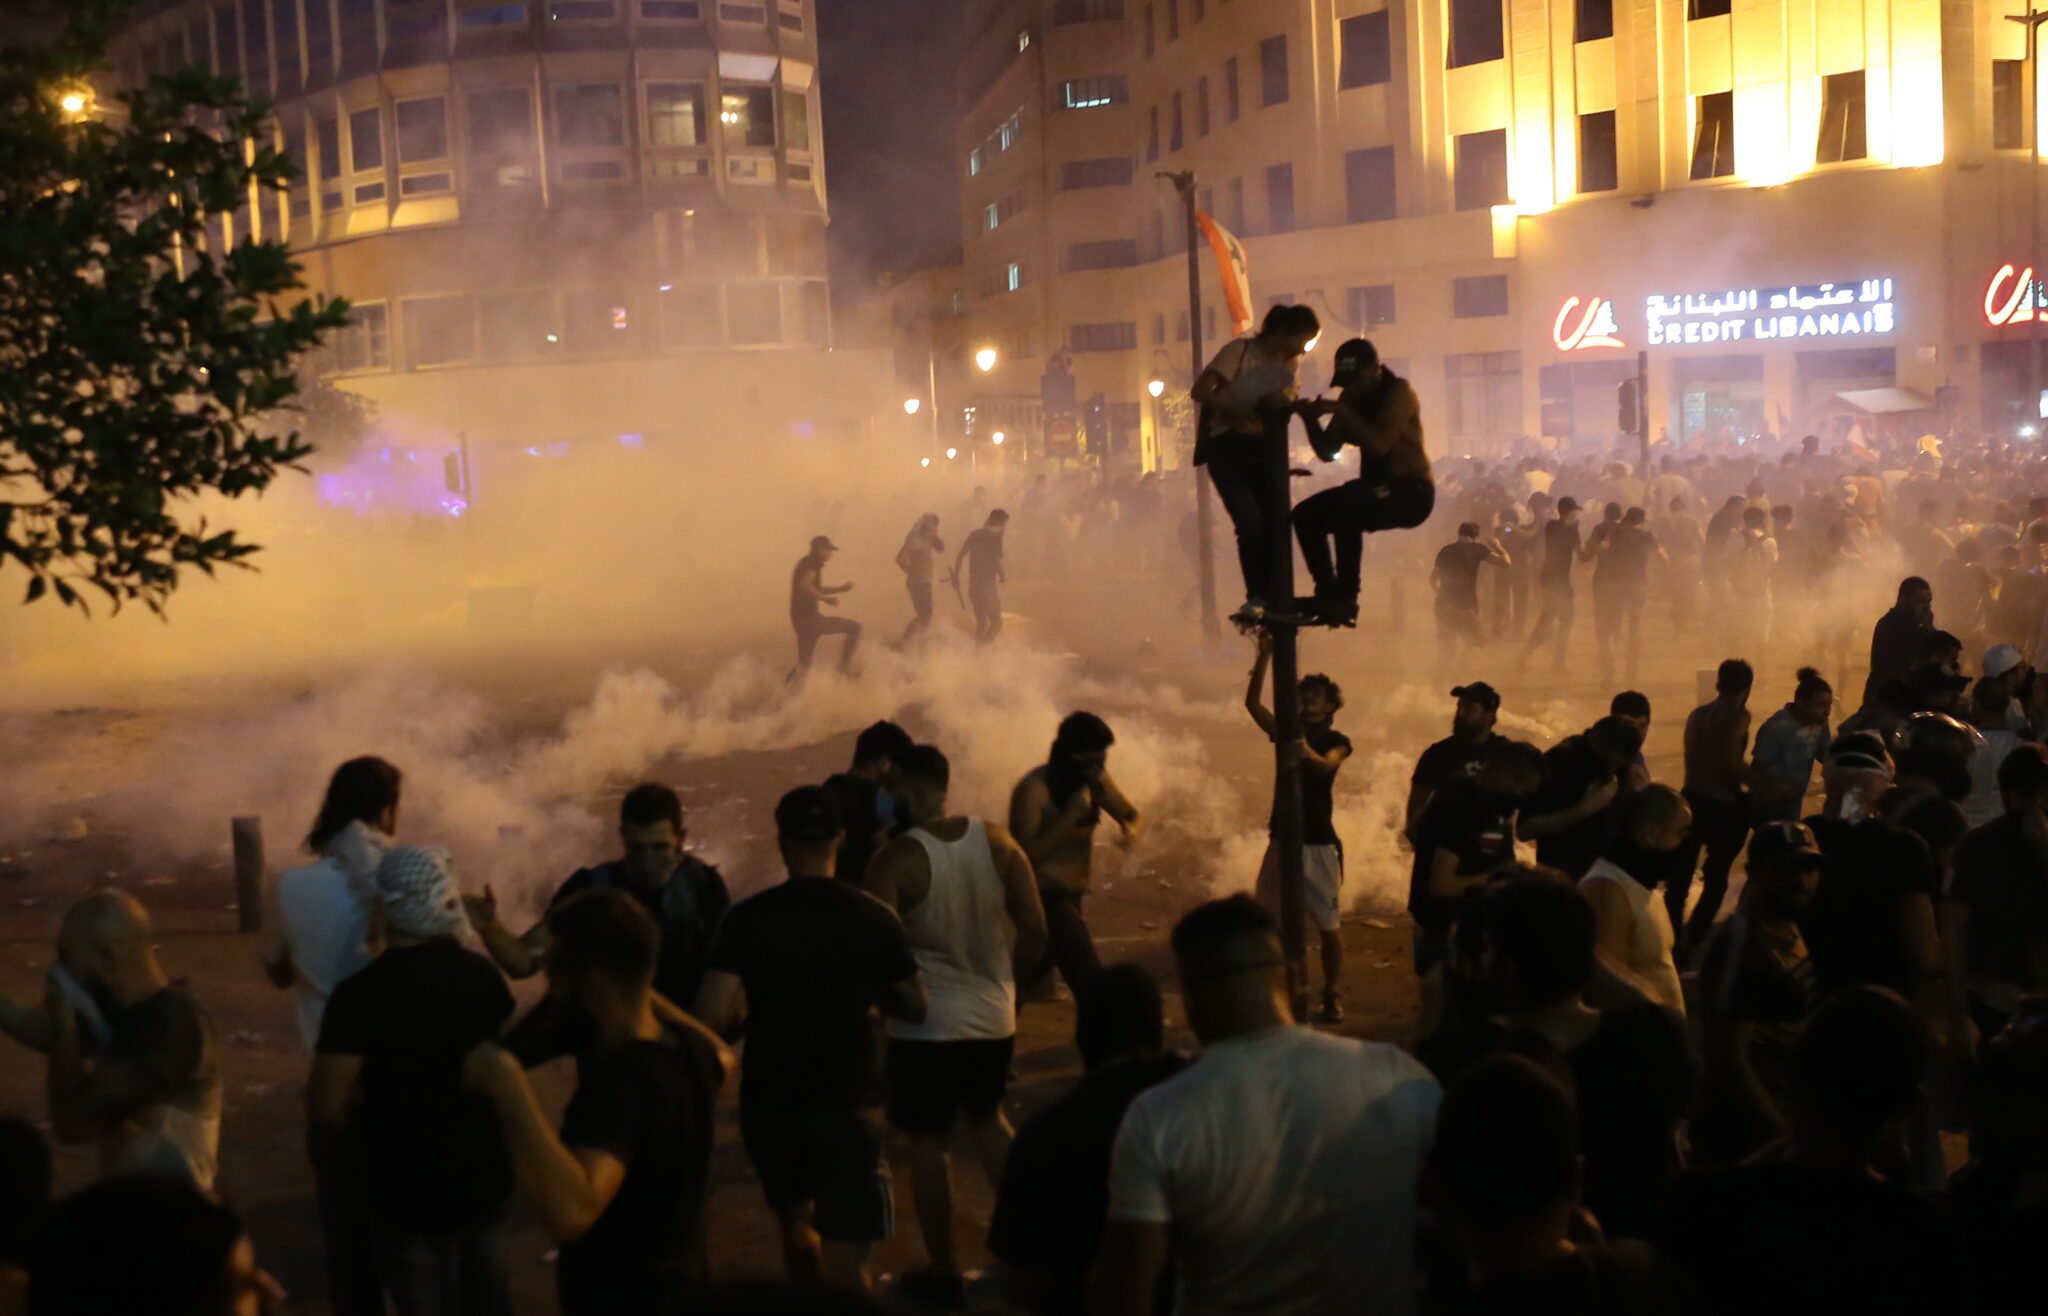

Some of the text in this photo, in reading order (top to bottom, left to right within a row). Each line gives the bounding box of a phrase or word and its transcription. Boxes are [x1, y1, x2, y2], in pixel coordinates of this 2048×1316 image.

[1769, 278, 1893, 309] الاعتماد
[1648, 307, 1893, 345] CREDIT LIBANAIS
